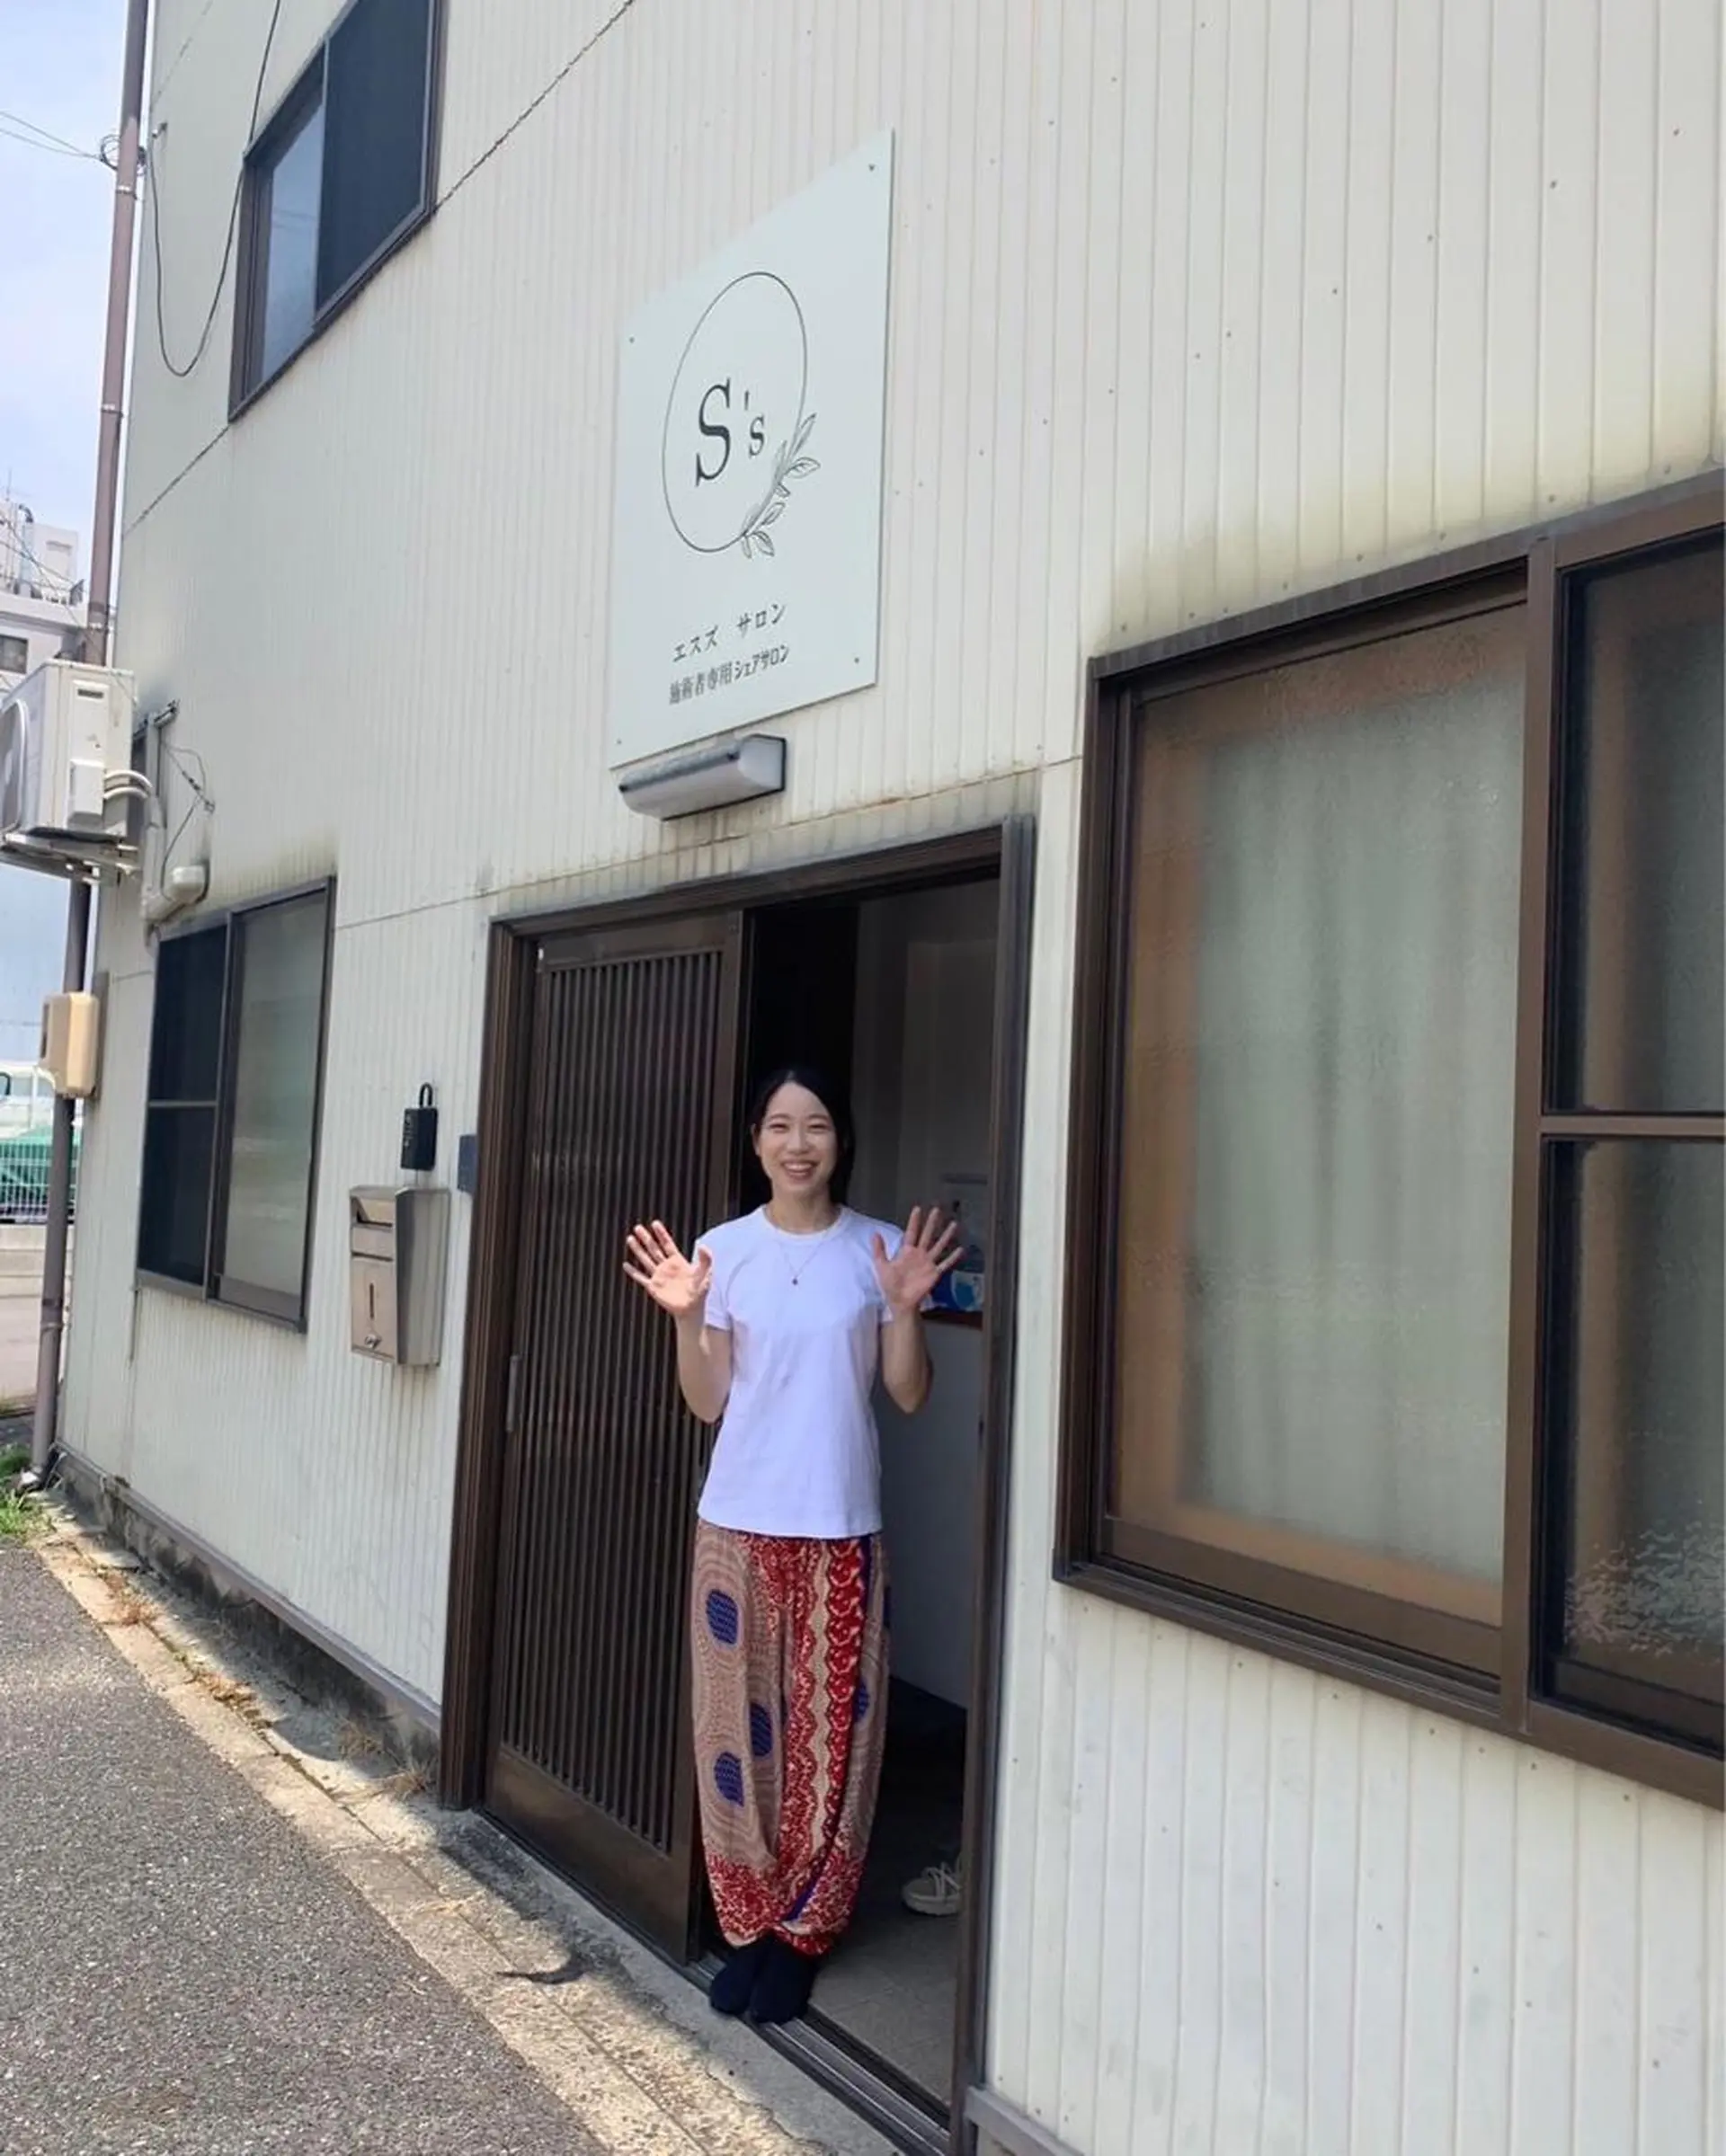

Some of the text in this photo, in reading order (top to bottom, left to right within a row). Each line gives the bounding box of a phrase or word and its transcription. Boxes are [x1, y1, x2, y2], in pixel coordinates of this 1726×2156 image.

[694, 377, 765, 487] S's
[736, 603, 787, 639] サロン
